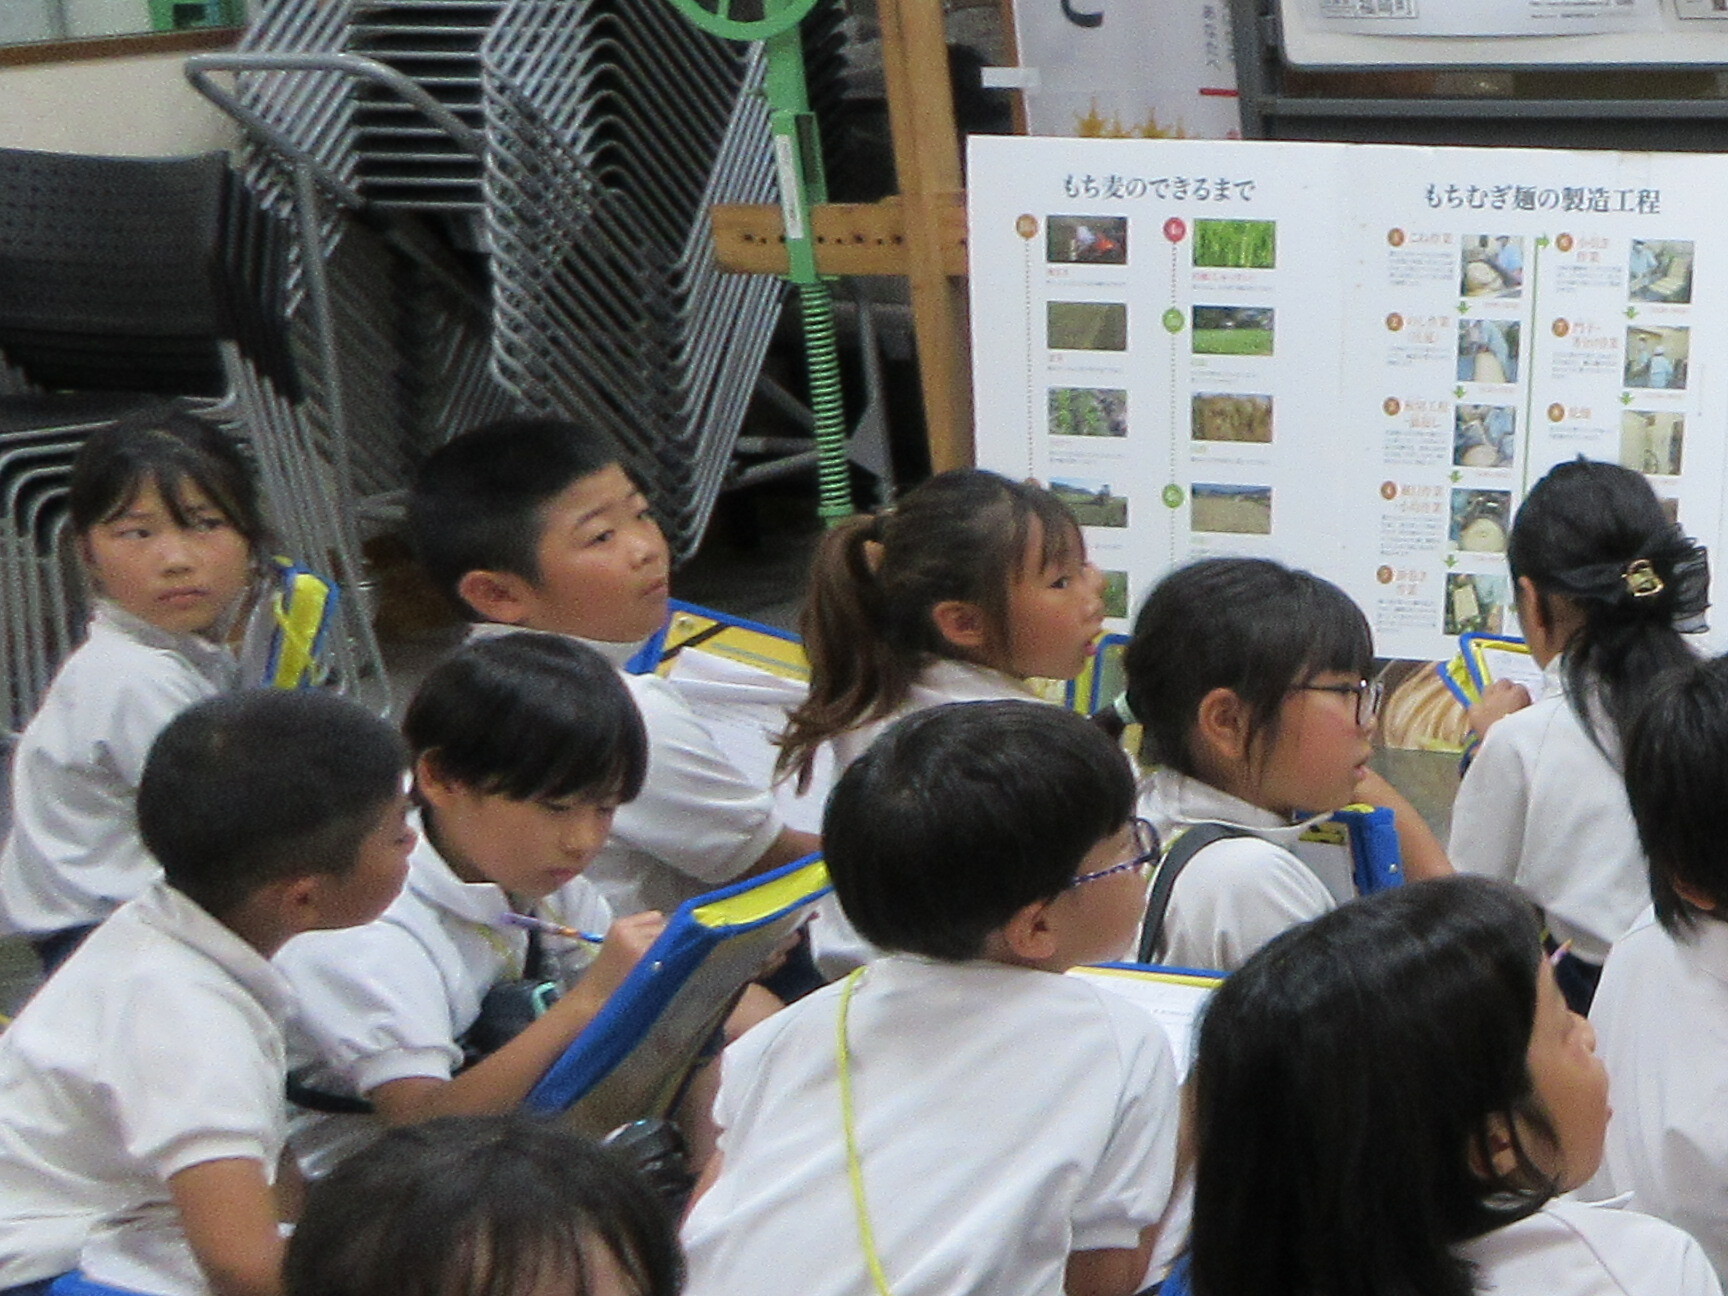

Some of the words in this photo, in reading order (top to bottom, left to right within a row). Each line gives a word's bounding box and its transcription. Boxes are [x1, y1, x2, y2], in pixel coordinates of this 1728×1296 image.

[1064, 173, 1256, 202] もち麦のできるまで
[1425, 183, 1661, 215] もちむぎ麺の製造工程
